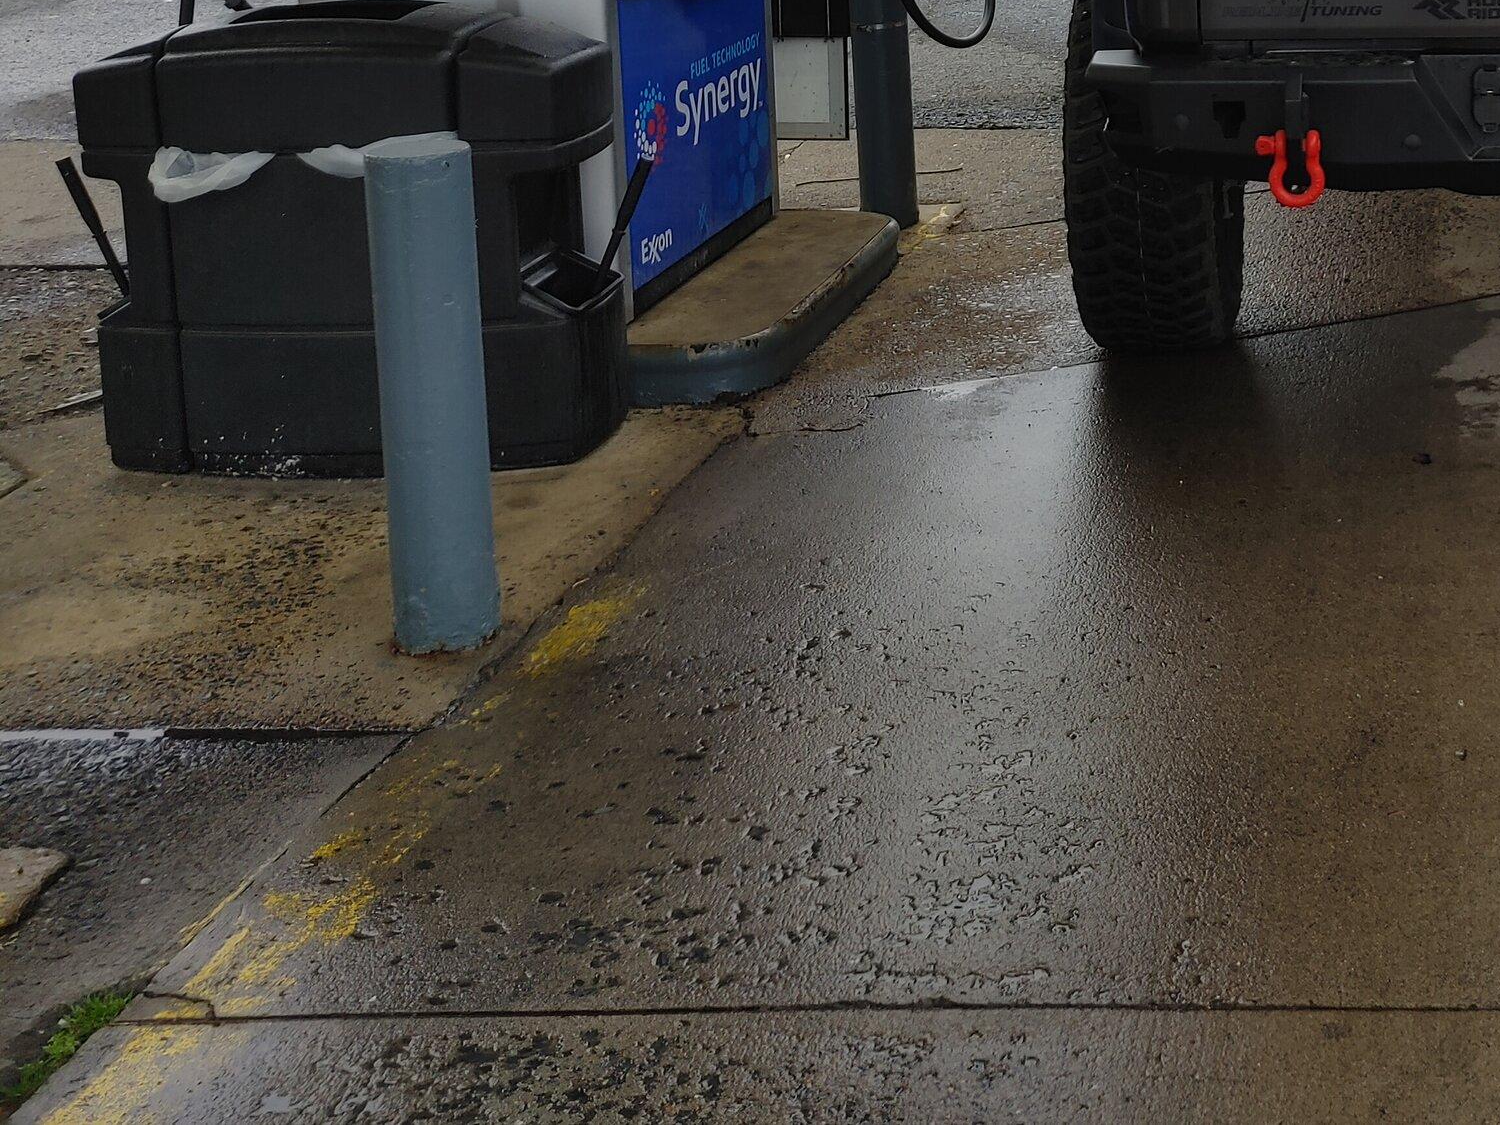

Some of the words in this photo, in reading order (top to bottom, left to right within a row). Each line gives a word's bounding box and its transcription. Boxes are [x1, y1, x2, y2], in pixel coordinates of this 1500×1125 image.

[1310, 4, 1384, 17] TUNING
[689, 56, 710, 79] FUEL
[711, 31, 761, 67] TECHNOLOGY
[674, 57, 762, 146] Synergy
[641, 228, 673, 265] Exxon
